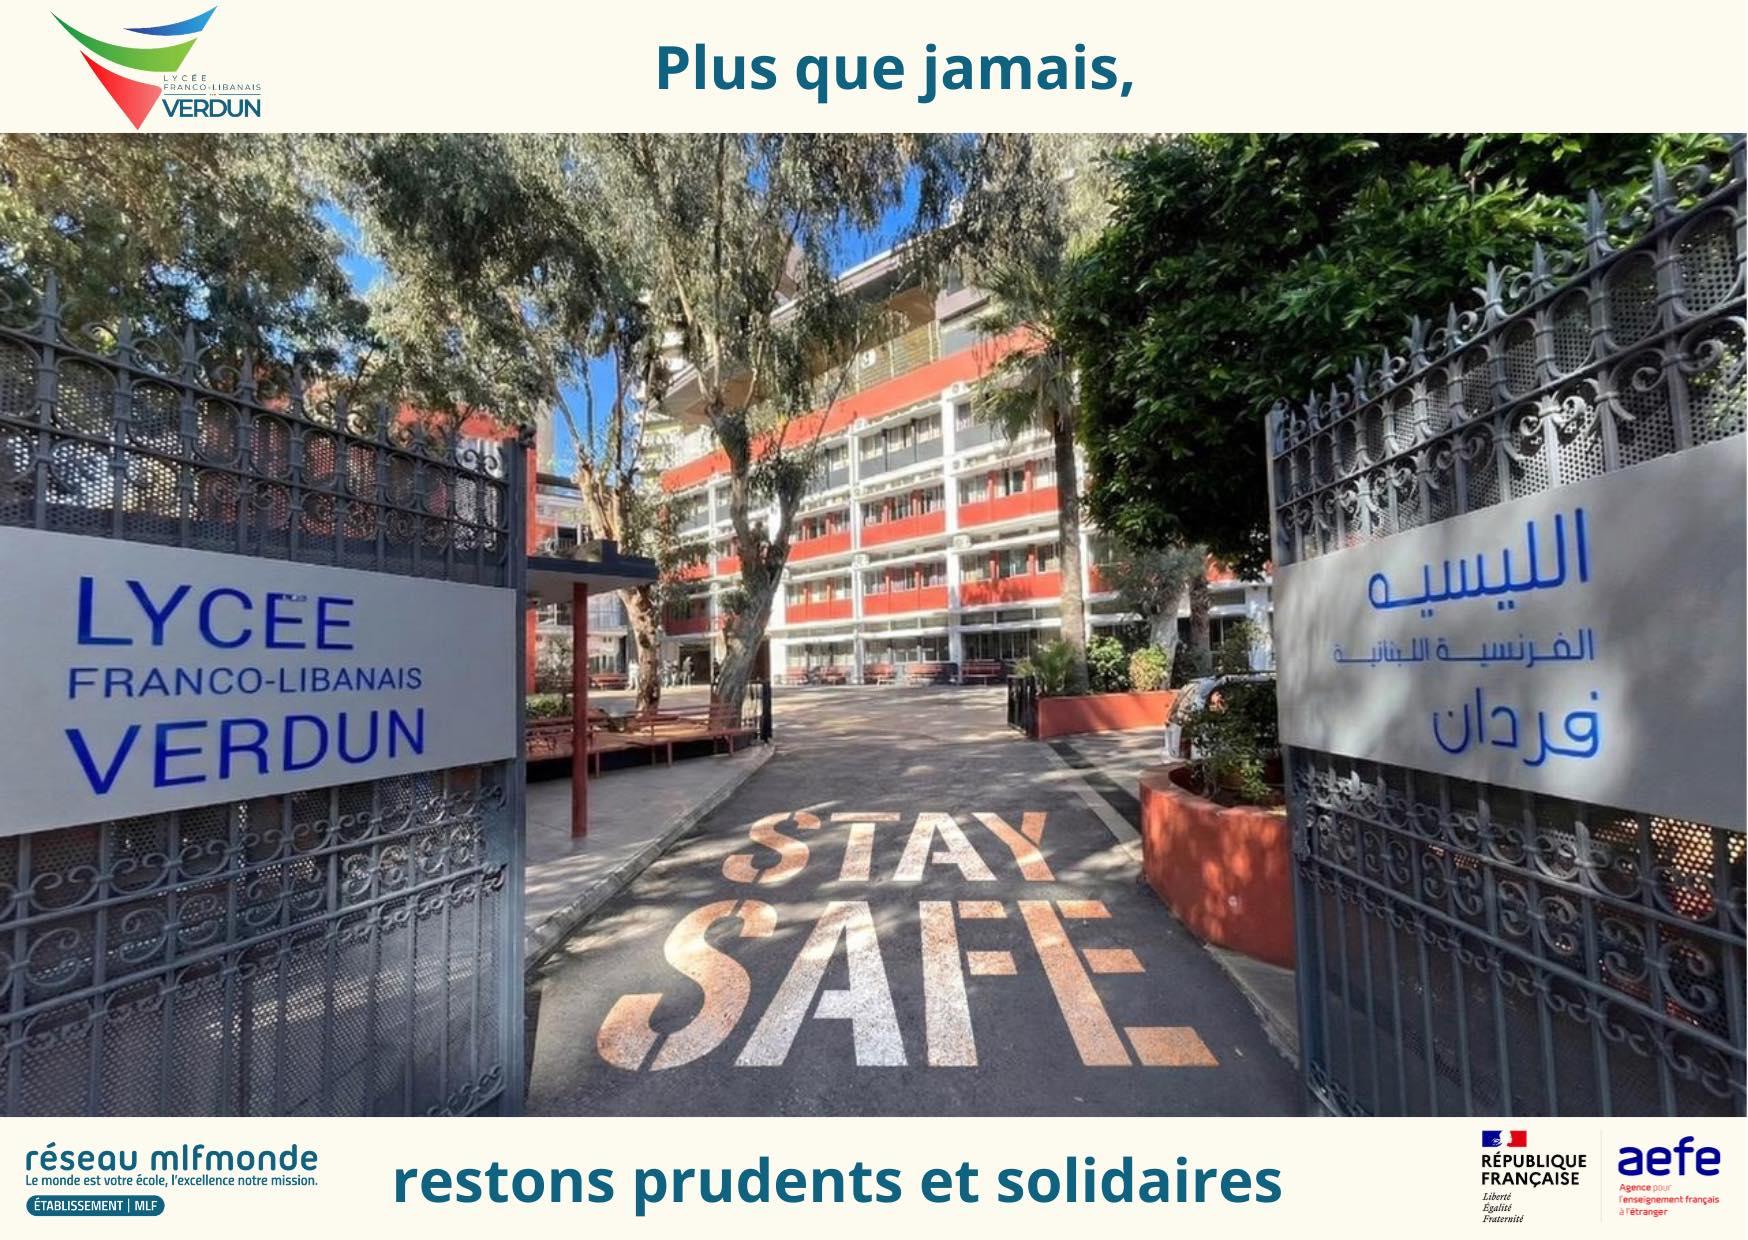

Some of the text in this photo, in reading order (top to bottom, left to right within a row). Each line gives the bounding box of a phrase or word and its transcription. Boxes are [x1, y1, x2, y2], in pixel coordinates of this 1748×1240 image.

[1367, 507, 1590, 618] الليسيه
[67, 666, 424, 700] FRANCO-LIBANAIS
[1436, 628, 1595, 669] الفرنسية
[65, 707, 426, 796] VERDUN
[1433, 687, 1600, 767] فردان
[721, 811, 1056, 884] STAY
[597, 899, 1221, 1072] SAFE
